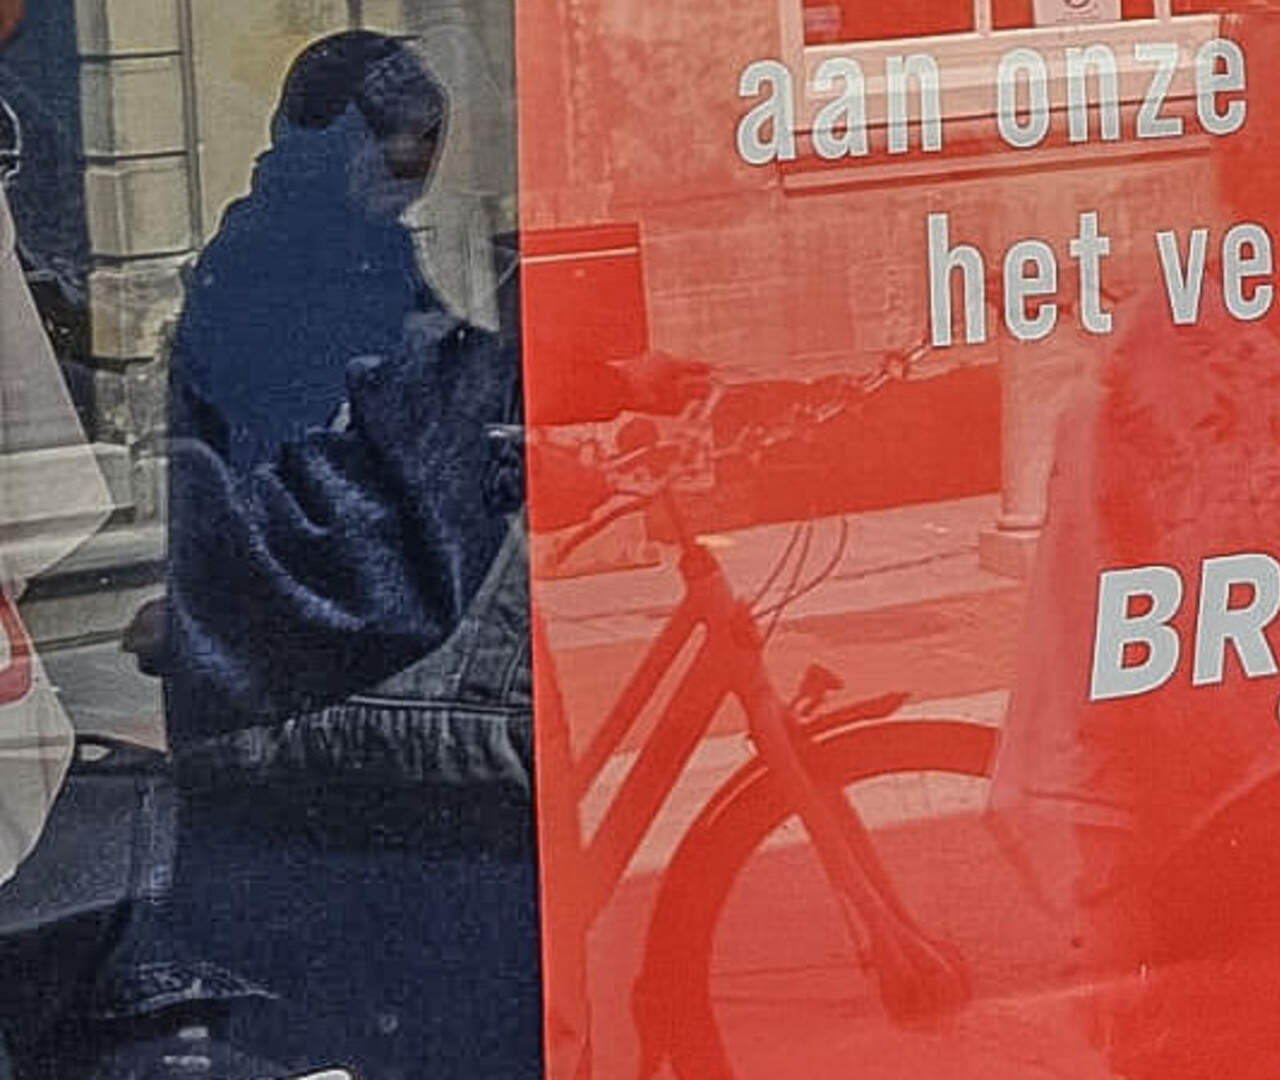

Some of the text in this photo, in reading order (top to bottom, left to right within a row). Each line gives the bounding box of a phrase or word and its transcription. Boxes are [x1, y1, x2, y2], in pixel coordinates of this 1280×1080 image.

[735, 54, 944, 166] aan
[998, 40, 1247, 151] onze
[924, 211, 1112, 347] het
